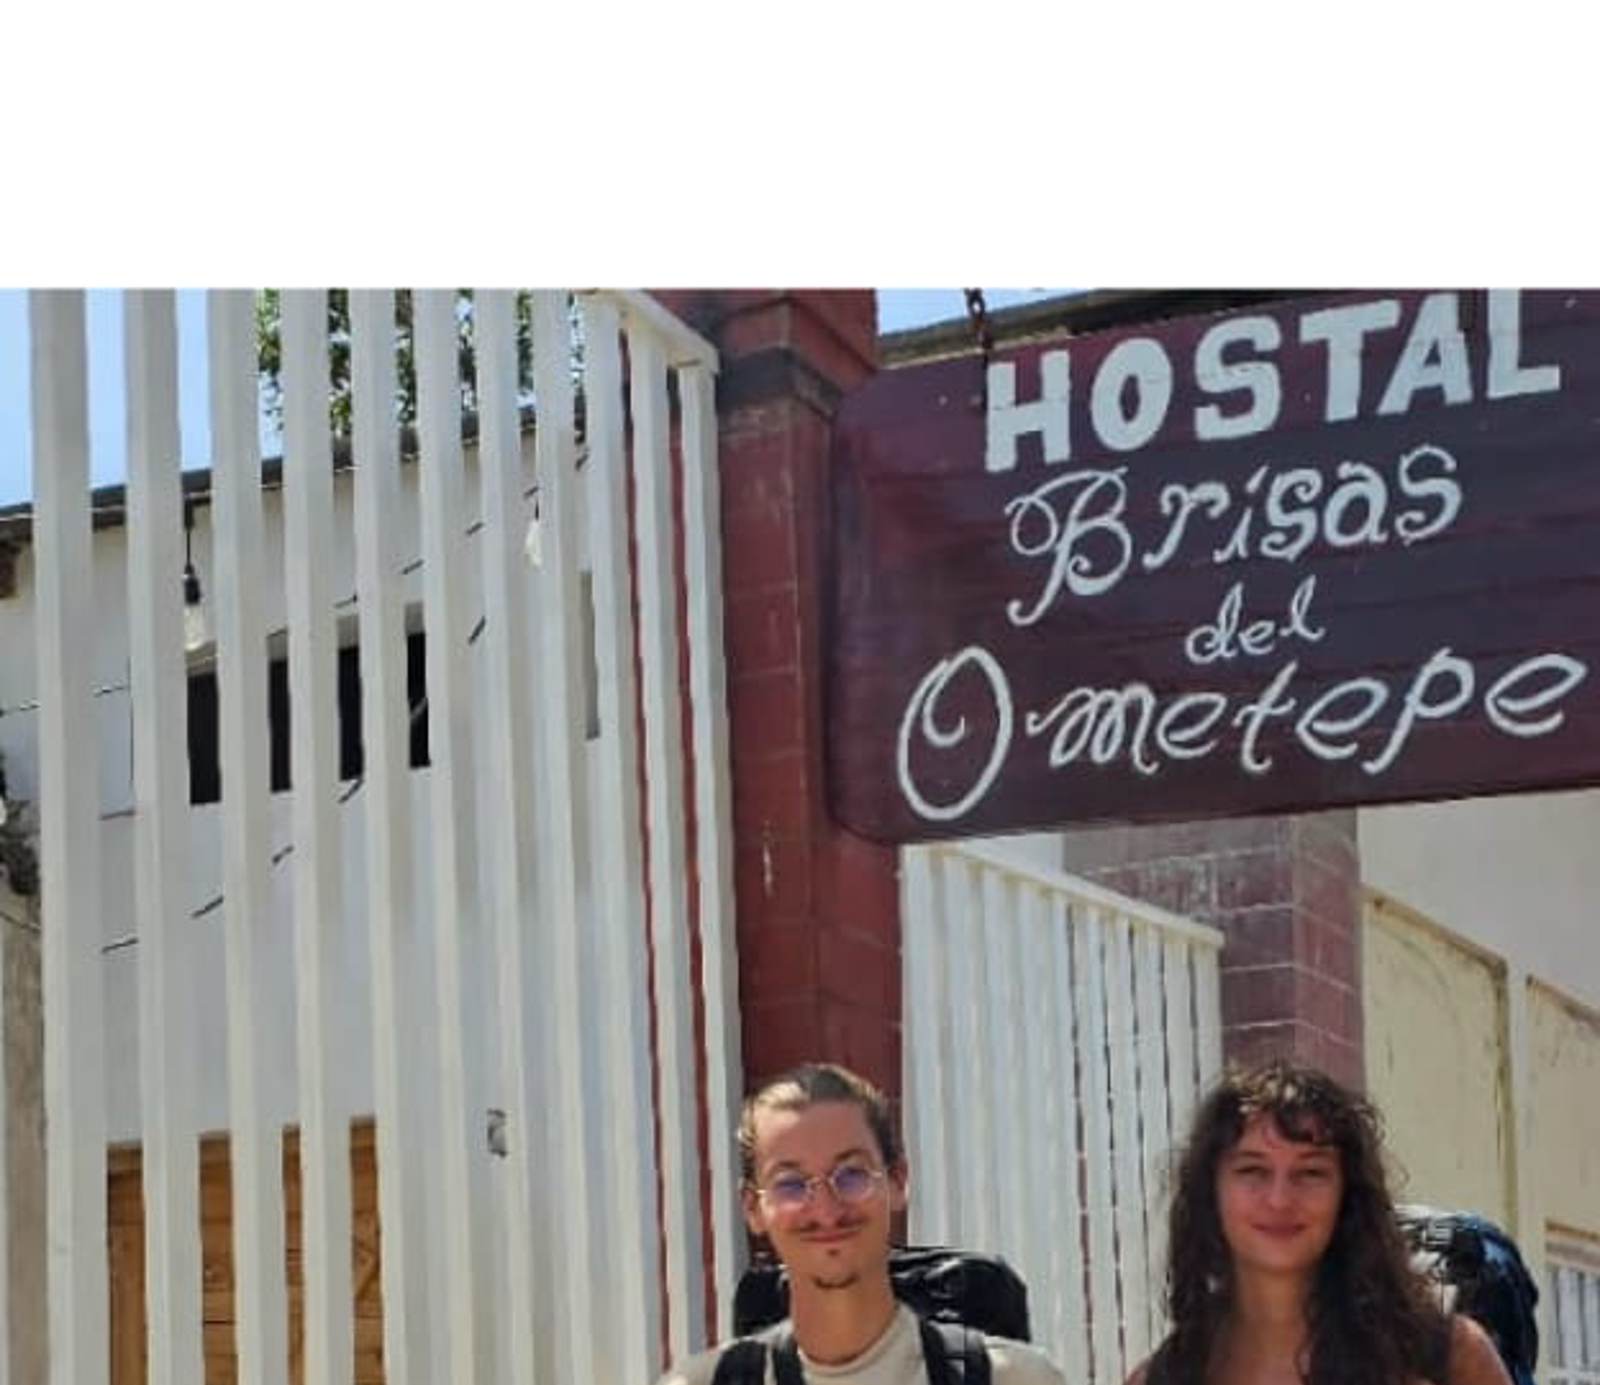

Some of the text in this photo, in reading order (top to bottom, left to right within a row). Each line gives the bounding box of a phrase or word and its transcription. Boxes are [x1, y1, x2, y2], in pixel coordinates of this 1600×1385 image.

[985, 288, 1560, 472] HOSTAL
[1005, 445, 1462, 625] Brisas
[1185, 575, 1324, 663] del
[899, 646, 1587, 820] Ometepe
